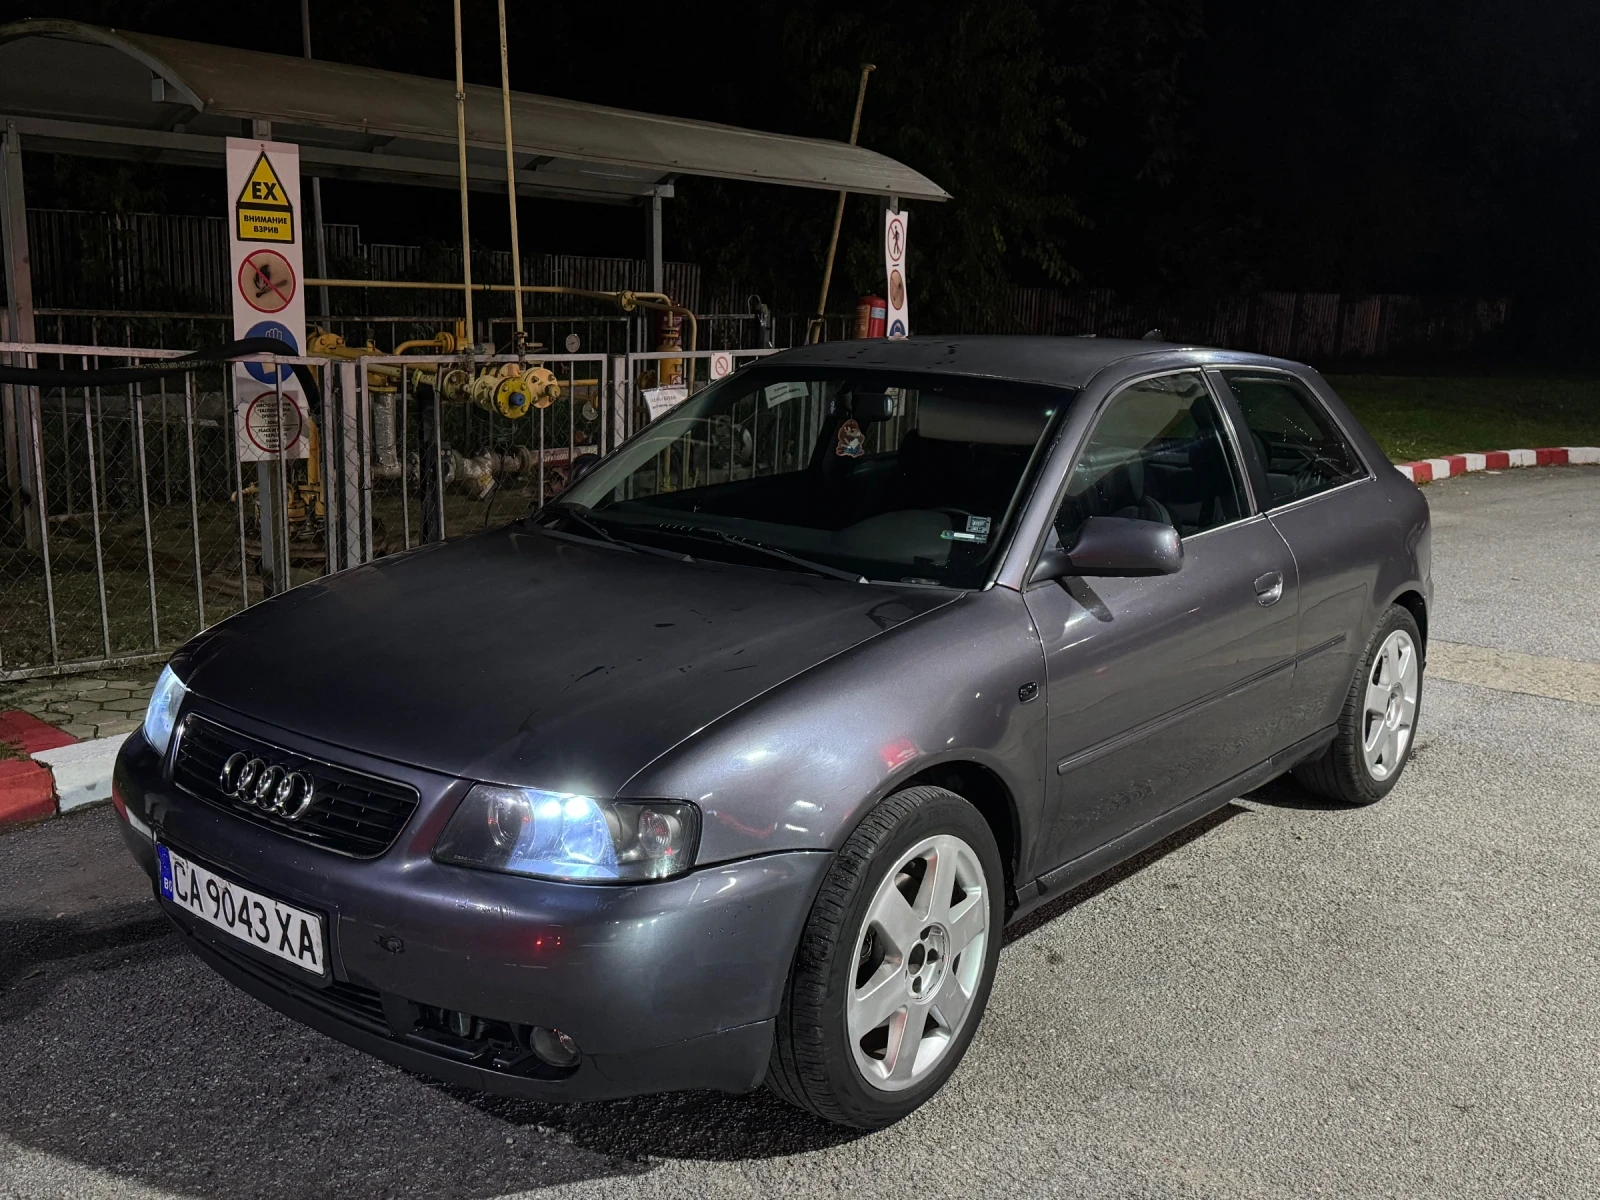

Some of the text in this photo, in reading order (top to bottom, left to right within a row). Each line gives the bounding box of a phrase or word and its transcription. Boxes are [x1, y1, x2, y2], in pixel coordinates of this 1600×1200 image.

[252, 181, 278, 201] EX
[244, 215, 287, 224] ВНИМАНИЕ
[253, 226, 279, 234] ВЗРИВ
[164, 877, 173, 892] BG
[174, 862, 317, 965] CA 9043 XA
